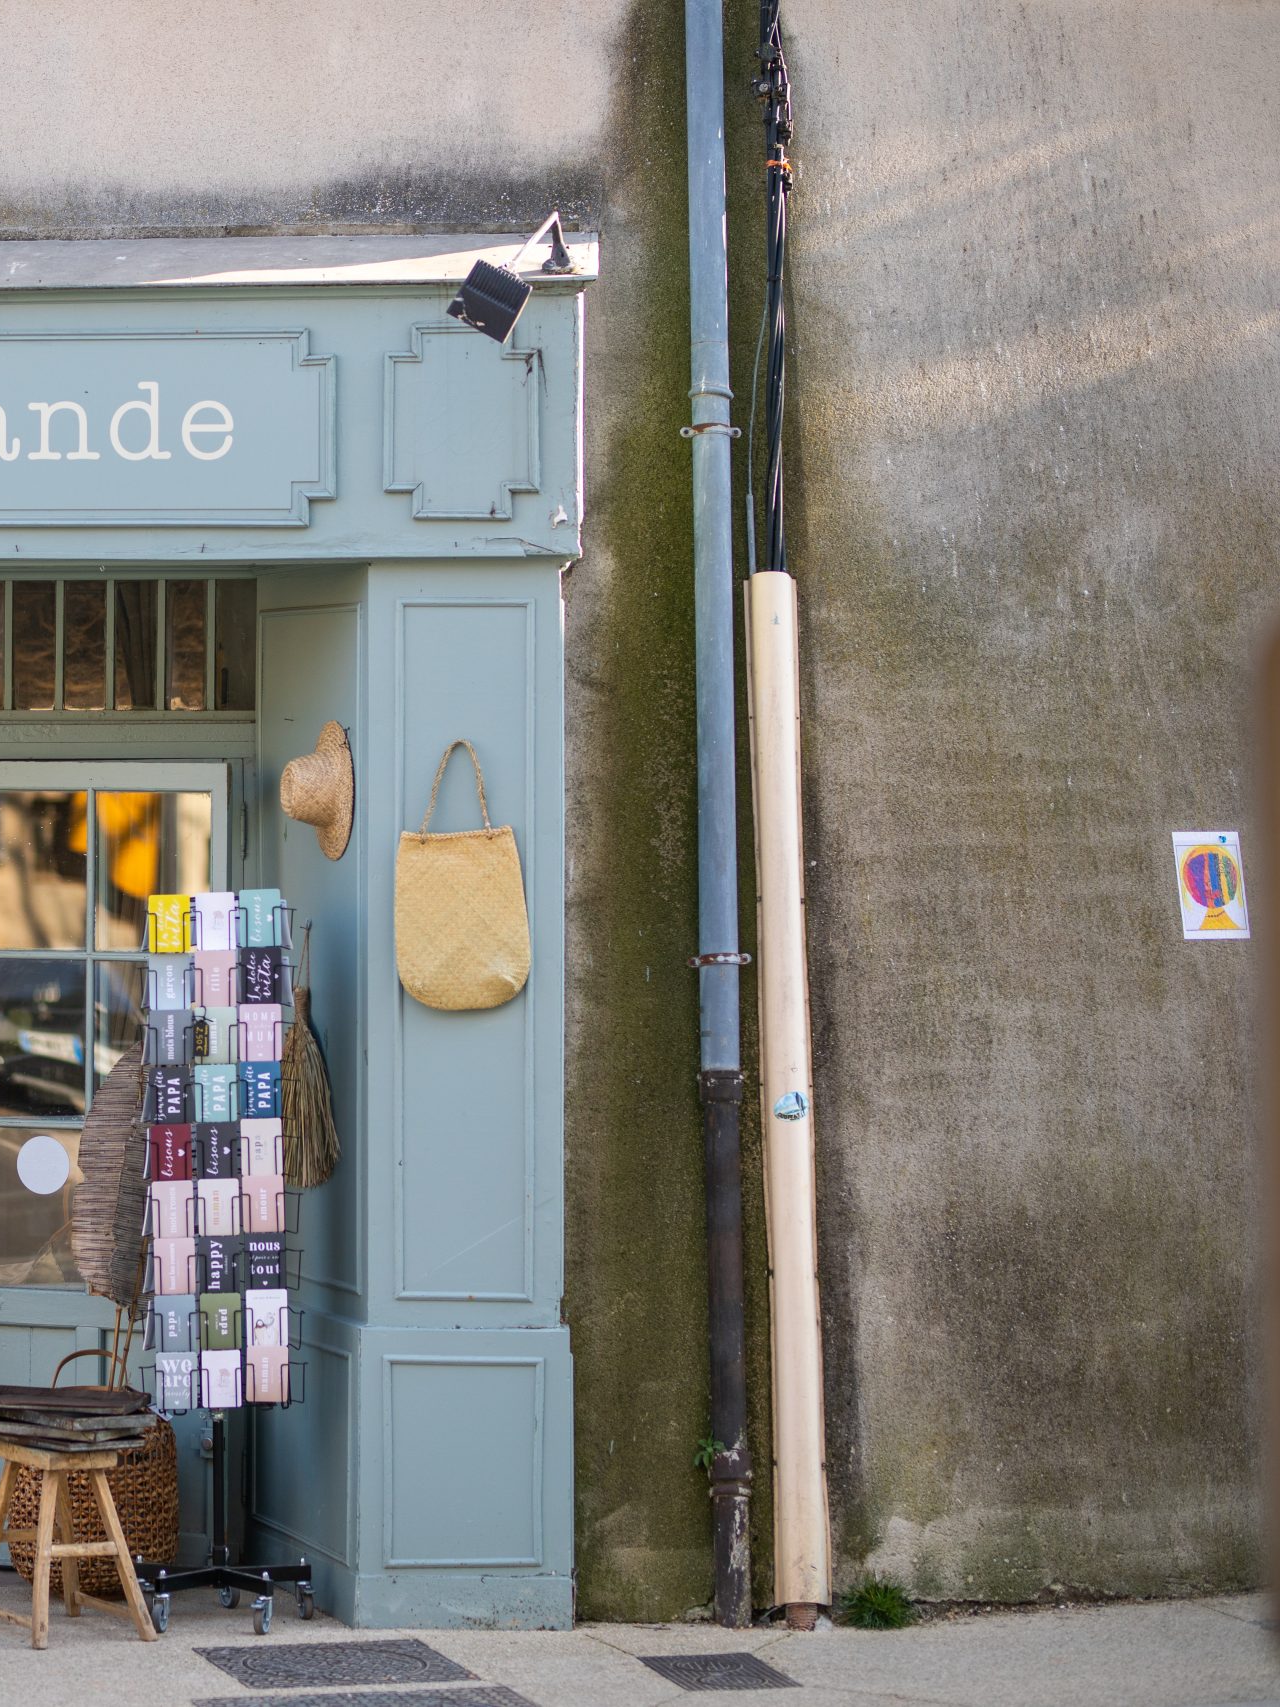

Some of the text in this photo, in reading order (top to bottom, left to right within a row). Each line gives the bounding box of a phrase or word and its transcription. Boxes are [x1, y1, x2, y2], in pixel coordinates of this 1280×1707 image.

[250, 895, 261, 942] bisous
[166, 964, 175, 999] garçon
[210, 966, 220, 992] fille
[247, 951, 257, 984] dolce
[259, 953, 272, 998] vita
[244, 1011, 276, 1022] HOME
[166, 1013, 175, 1061] mots bleus
[167, 1076, 181, 1114] PAPA
[212, 1074, 226, 1112] PAPA
[258, 1071, 272, 1109] PAPA
[161, 1129, 173, 1177] bisous
[206, 1126, 219, 1176] bisous
[255, 1134, 263, 1161] papa
[259, 1188, 268, 1221] amour
[249, 1241, 281, 1251] nous
[207, 1240, 224, 1290] happy
[250, 1262, 281, 1275] tout
[168, 1310, 177, 1338] papa
[219, 1308, 228, 1336] papa
[161, 1358, 193, 1373] we
[260, 1356, 269, 1393] maman
